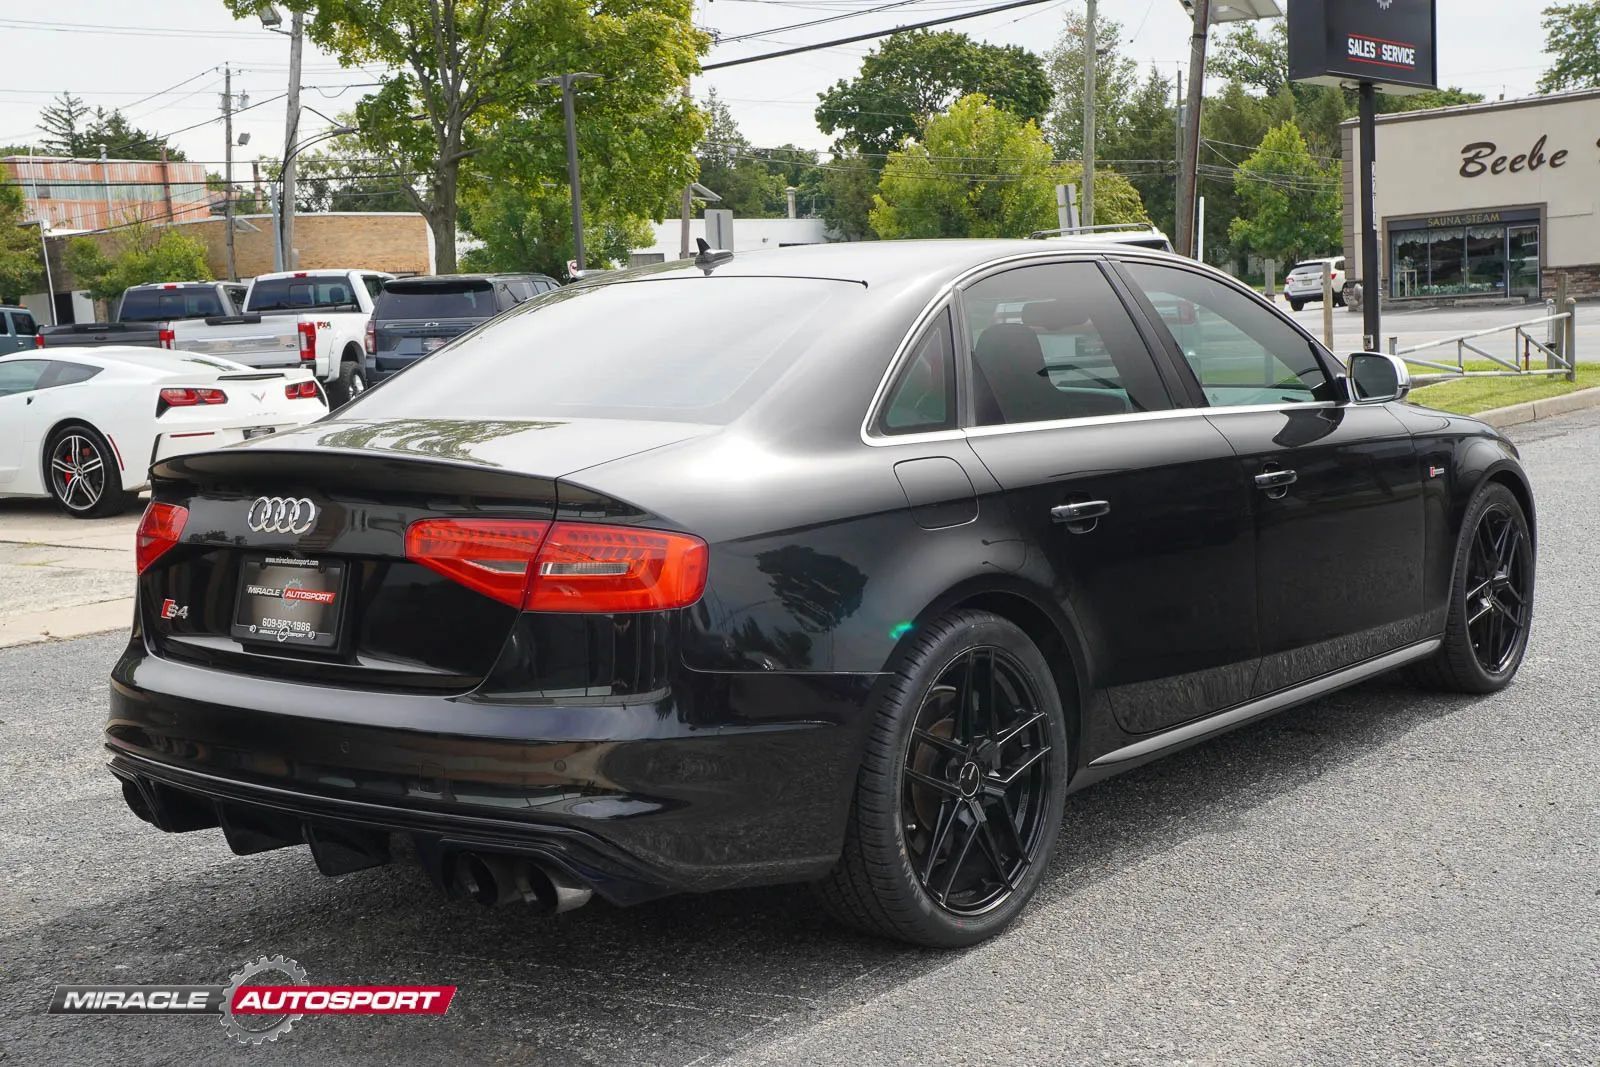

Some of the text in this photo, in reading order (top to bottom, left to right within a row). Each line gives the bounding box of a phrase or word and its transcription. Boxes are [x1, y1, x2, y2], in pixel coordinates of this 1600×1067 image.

[1348, 38, 1415, 65] SALES SERVICE
[1459, 134, 1568, 178] Beebe
[1427, 213, 1500, 227] SAUNA-STEAM
[247, 586, 332, 602] MIRACLE AUTOSPORT
[163, 601, 189, 619] S4
